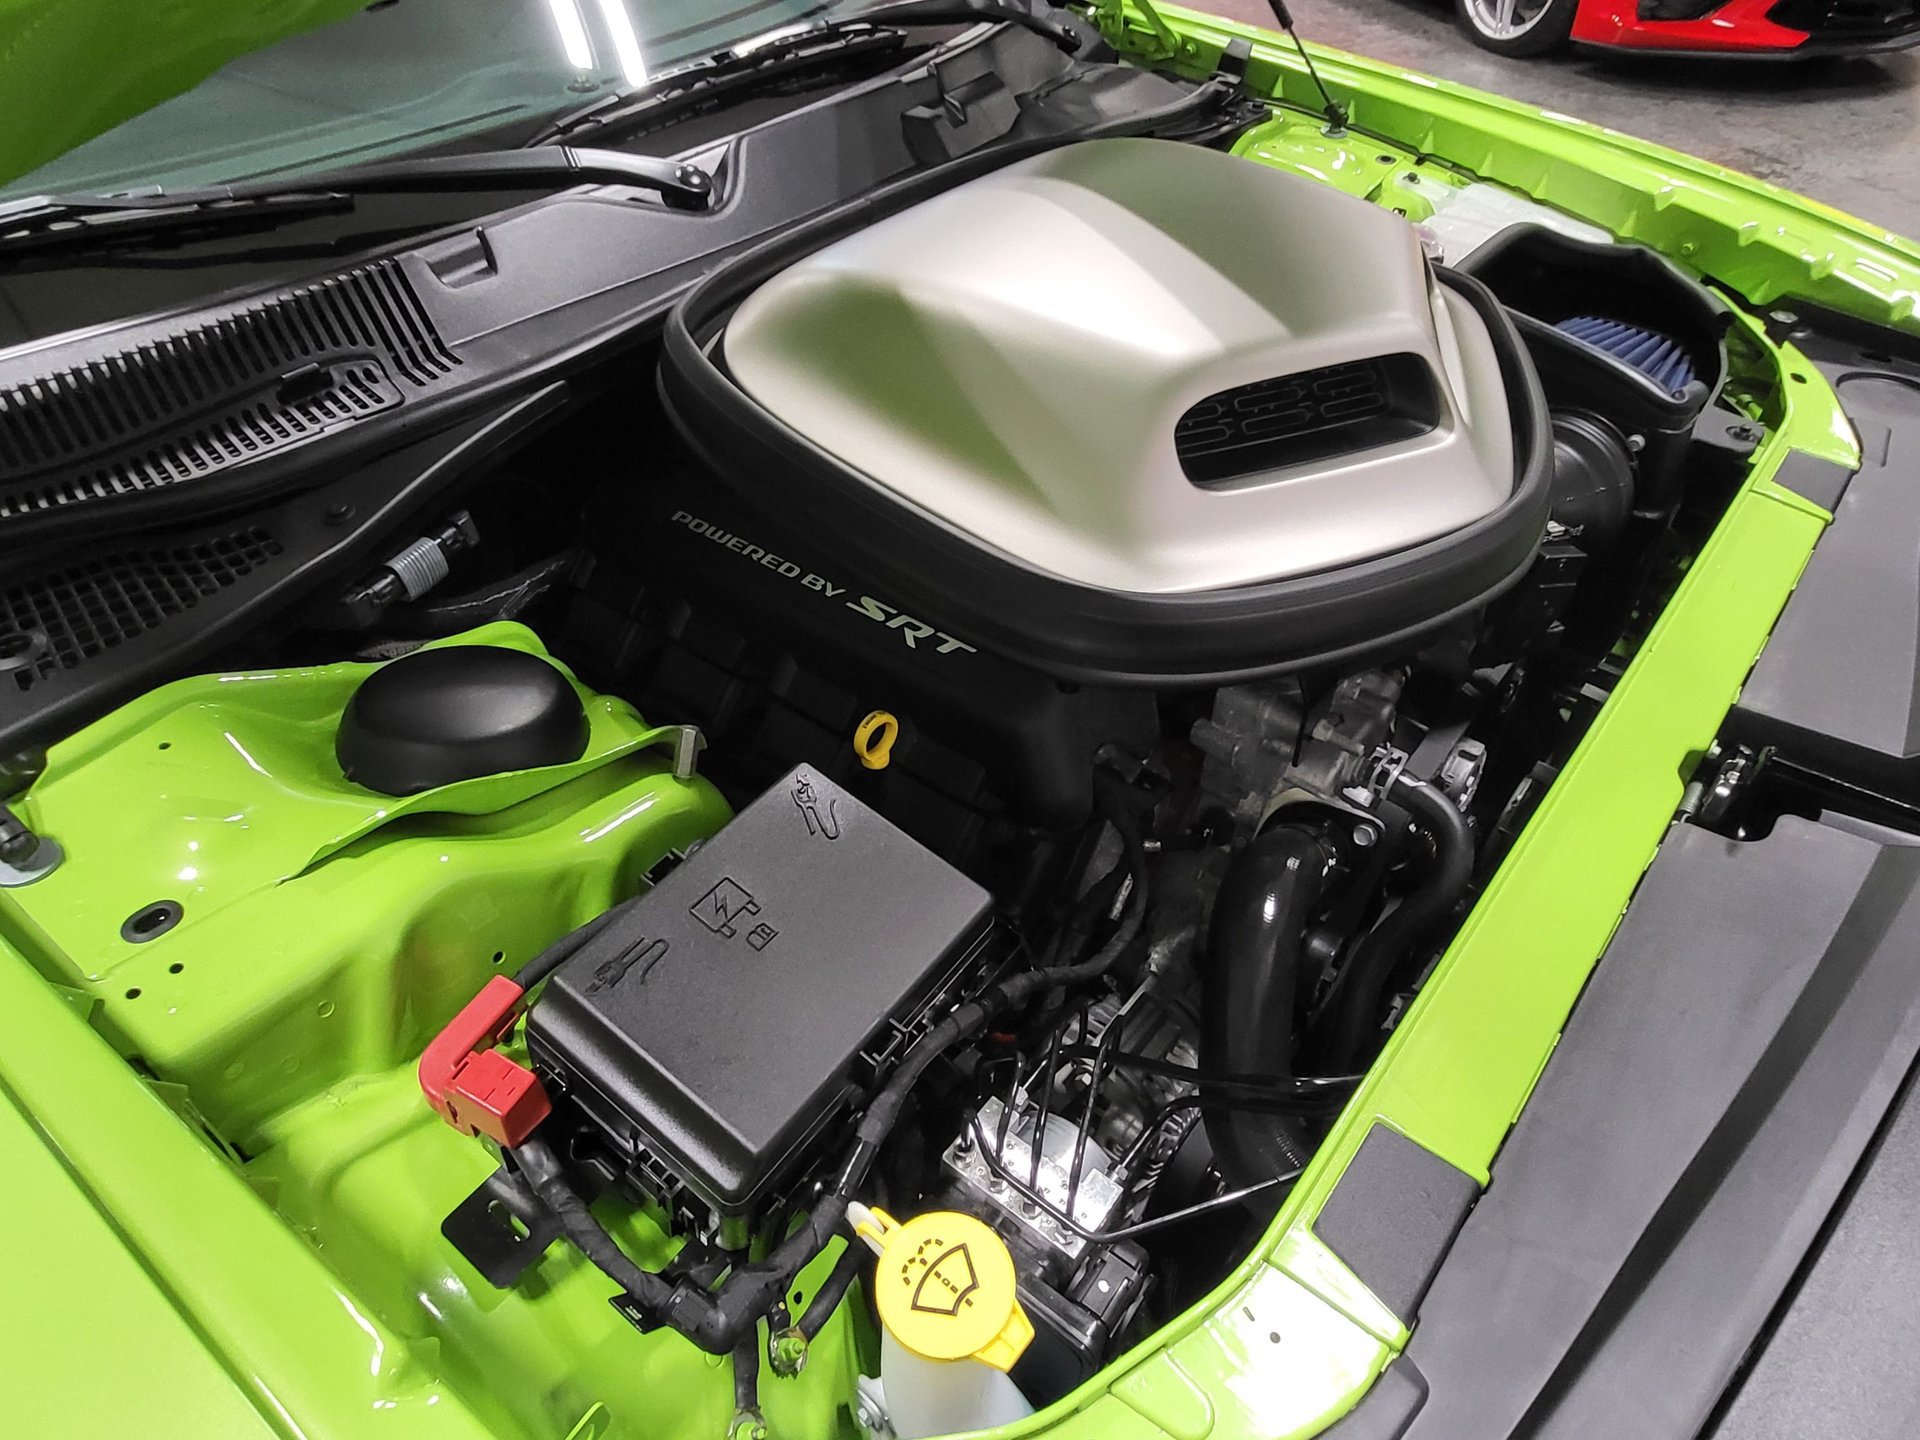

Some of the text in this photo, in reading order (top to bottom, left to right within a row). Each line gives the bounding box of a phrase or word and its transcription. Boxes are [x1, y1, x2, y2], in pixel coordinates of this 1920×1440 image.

[671, 510, 977, 654] POWERED BY SRT
